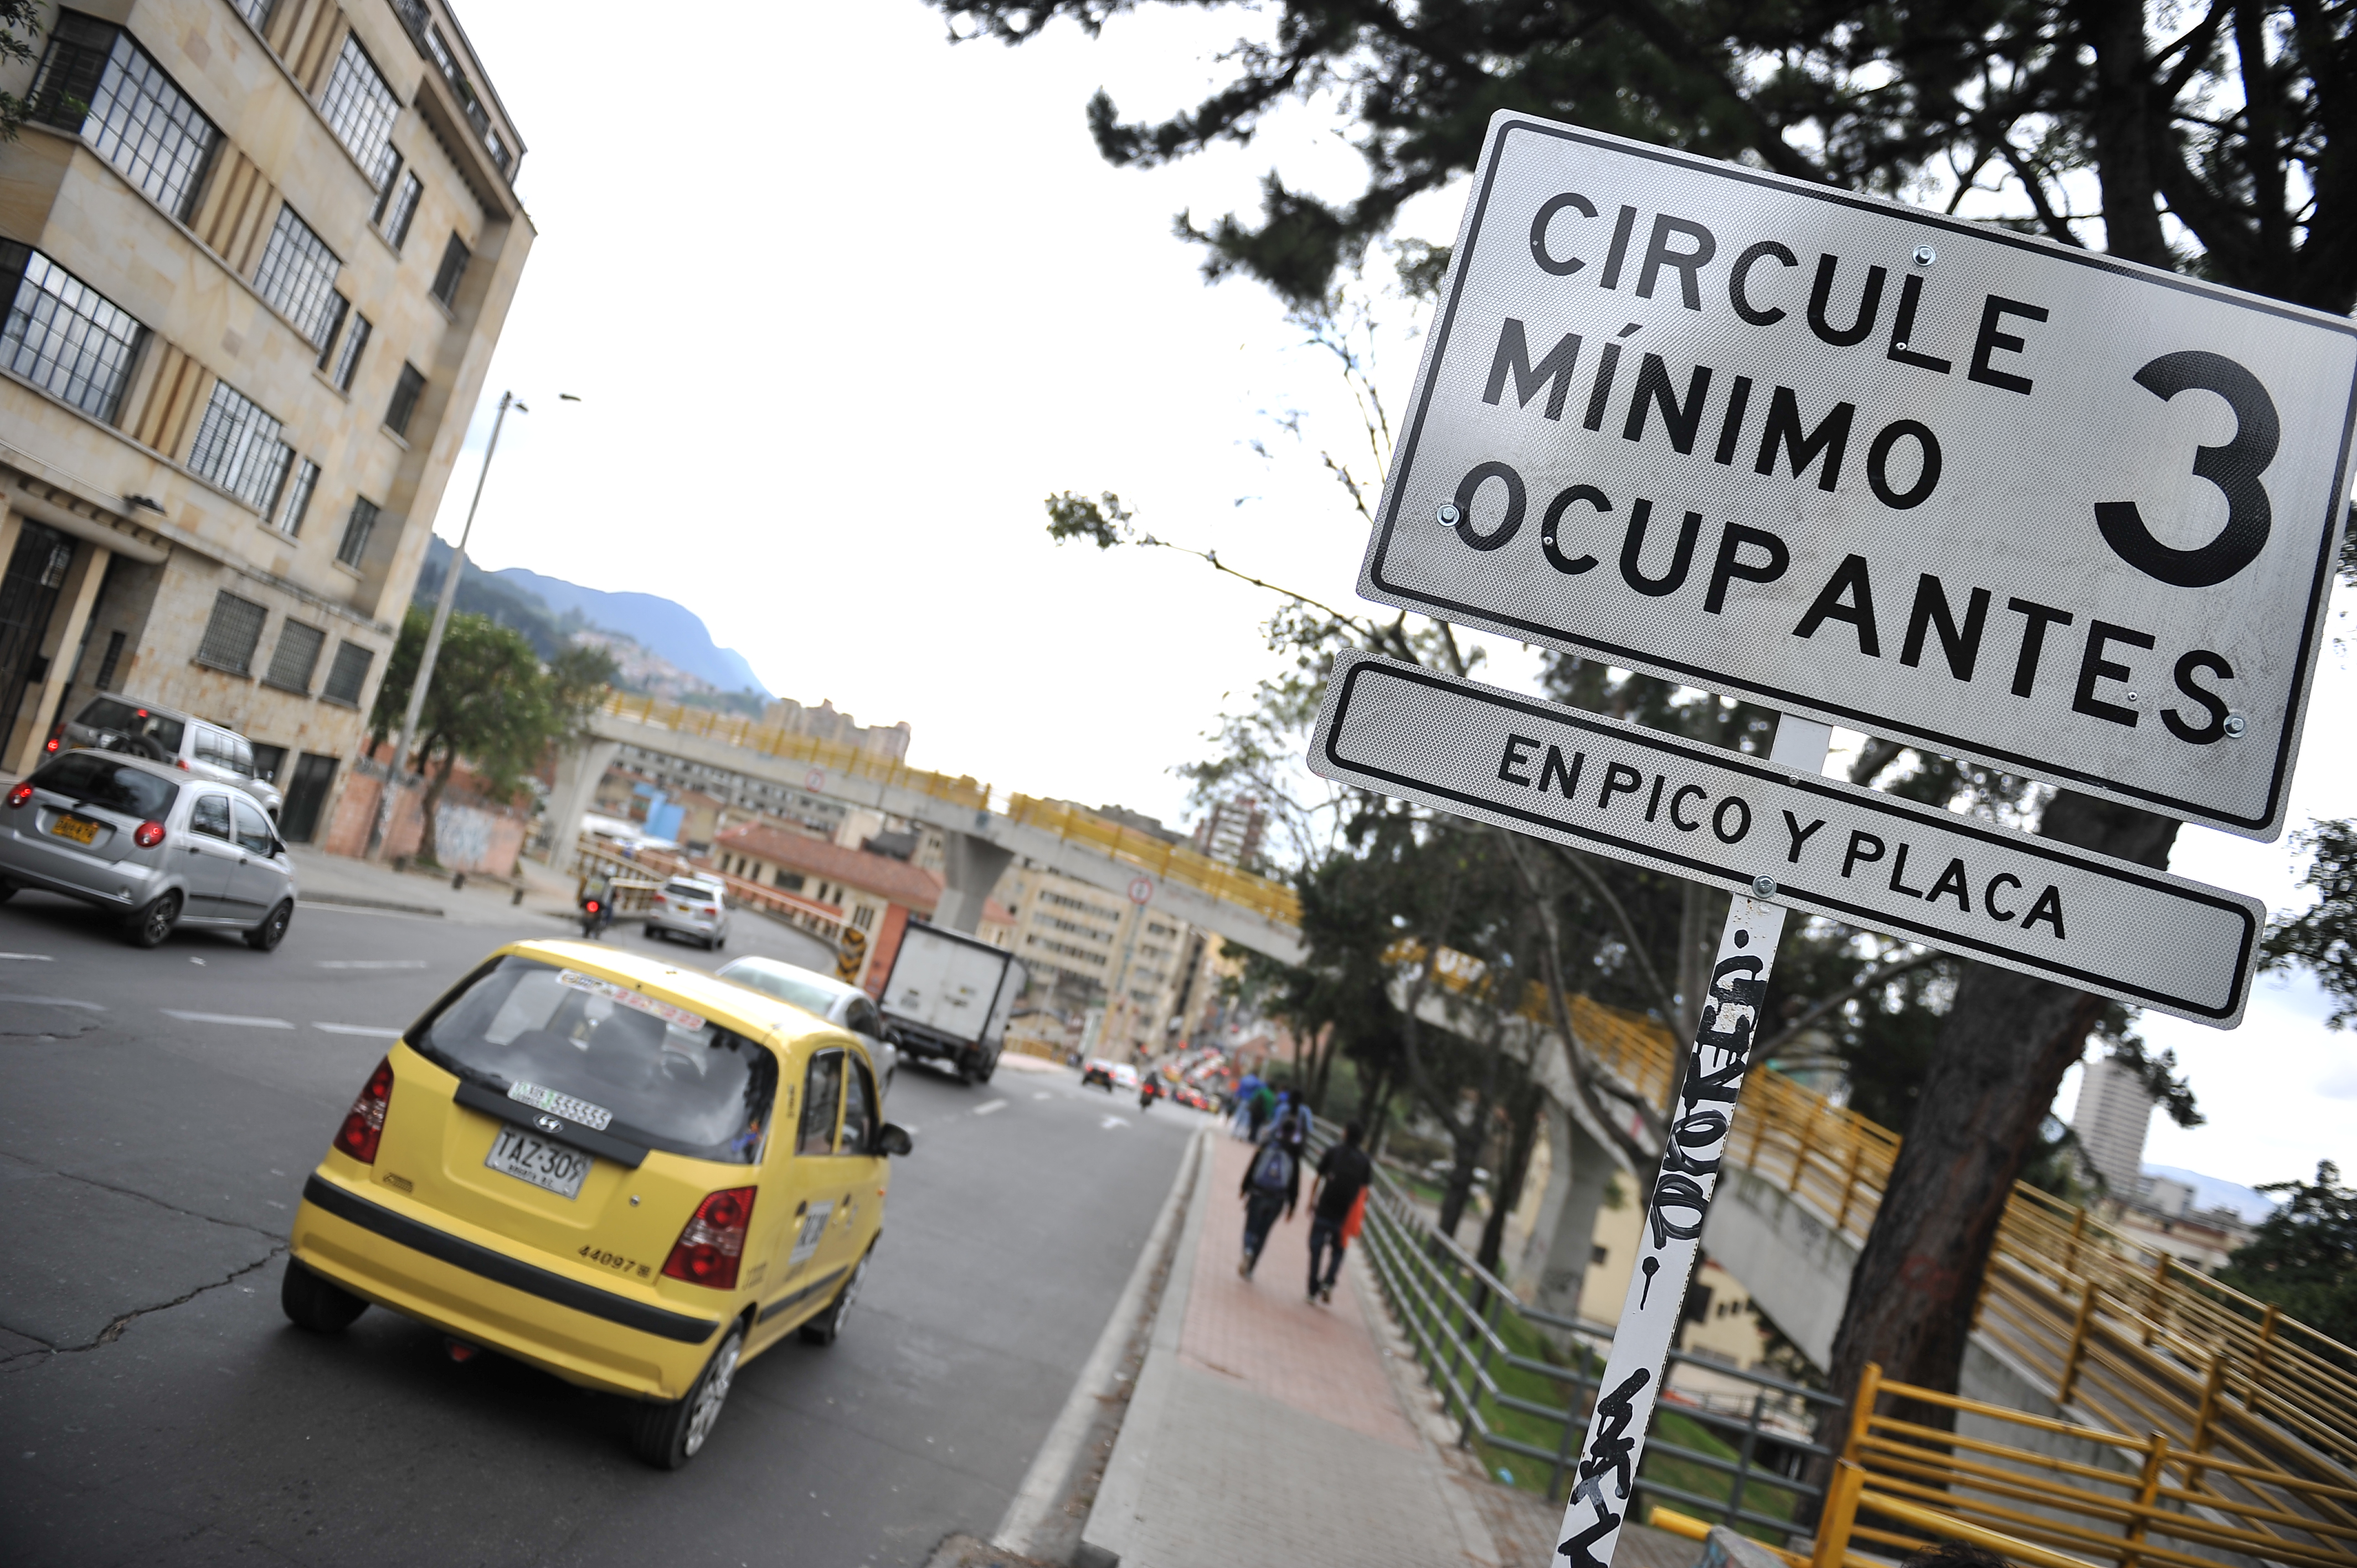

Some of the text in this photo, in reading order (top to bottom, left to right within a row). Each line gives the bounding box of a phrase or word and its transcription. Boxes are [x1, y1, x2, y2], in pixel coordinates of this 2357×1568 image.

[1530, 191, 2049, 395] CIRCULE
[1483, 318, 1942, 510] MÍNIMO
[2094, 350, 2281, 589] 3
[1454, 460, 2237, 746] OCUPANTES
[1497, 733, 2066, 940] EN PICO Y PLACA
[578, 1245, 636, 1273] 44097
